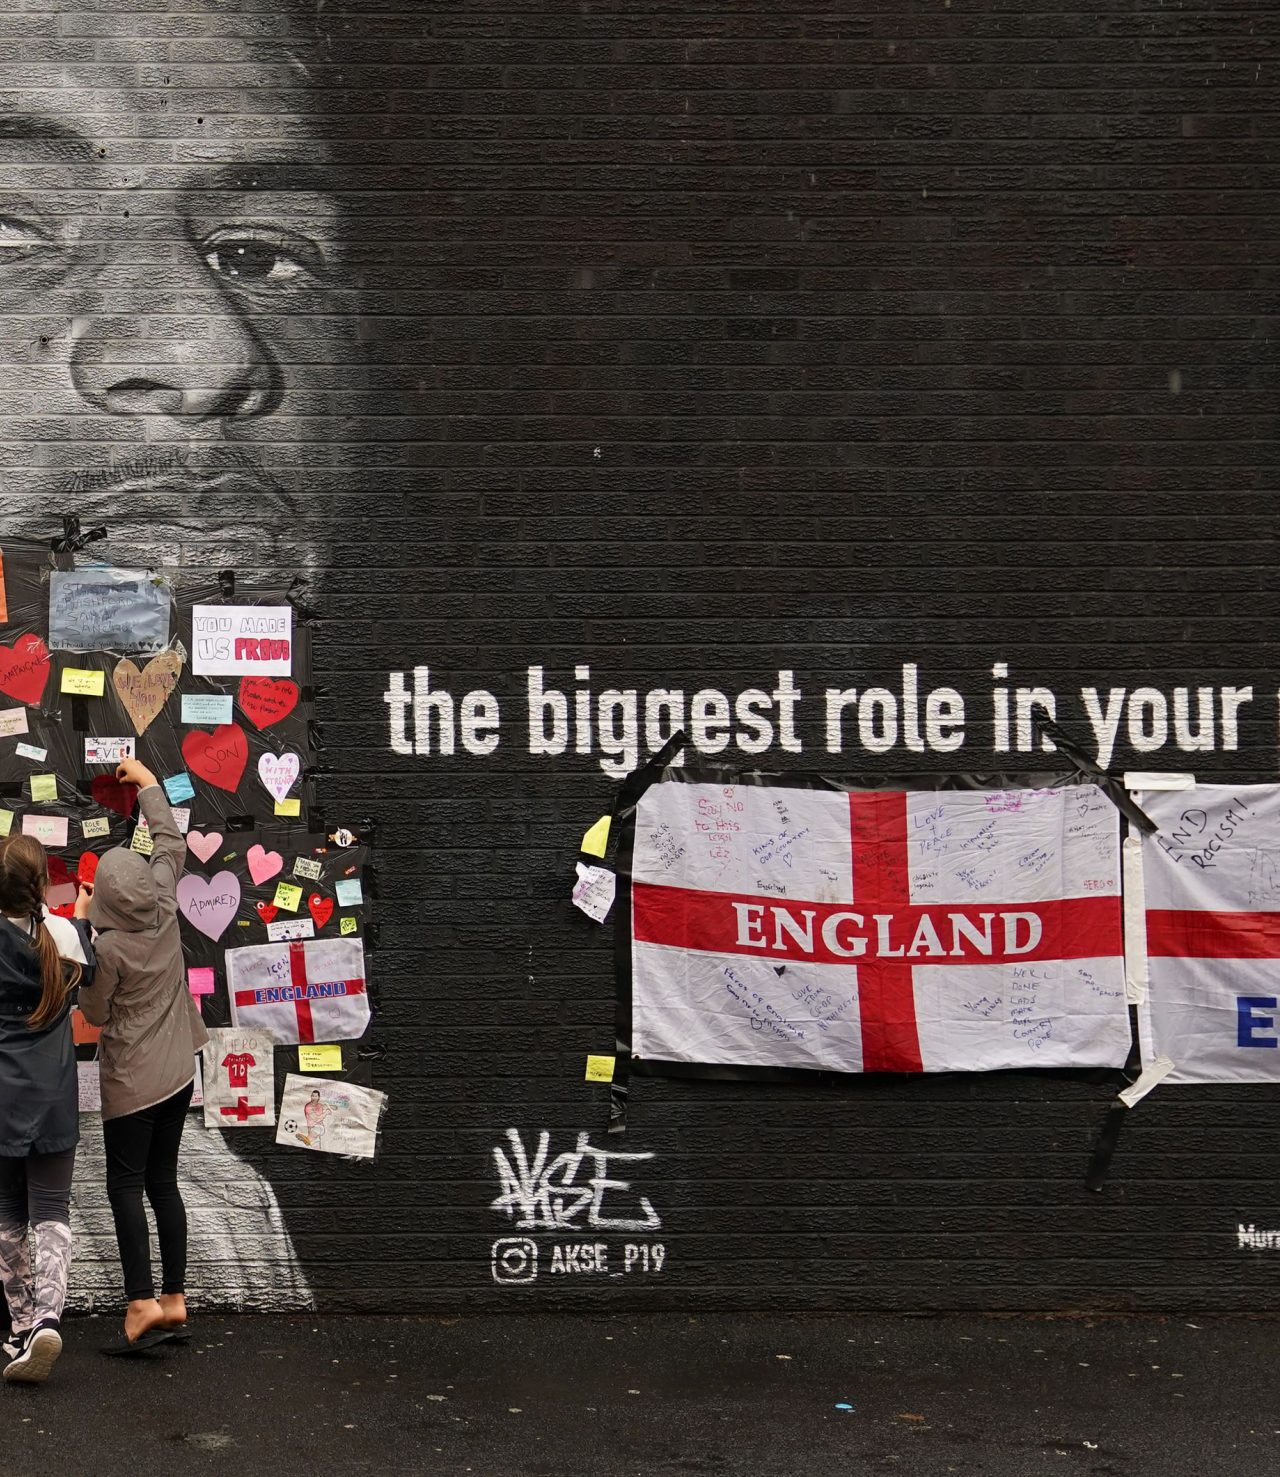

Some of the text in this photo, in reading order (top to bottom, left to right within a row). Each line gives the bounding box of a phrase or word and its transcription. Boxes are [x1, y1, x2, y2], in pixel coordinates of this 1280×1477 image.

[194, 616, 285, 633] YOU MADE
[198, 637, 230, 660] US
[384, 664, 1253, 777] the biggest role in your
[1157, 809, 1207, 862] END
[189, 894, 236, 917] ADMIRED
[732, 902, 1042, 958] ENGLAND
[255, 982, 347, 1004] ENGLAND
